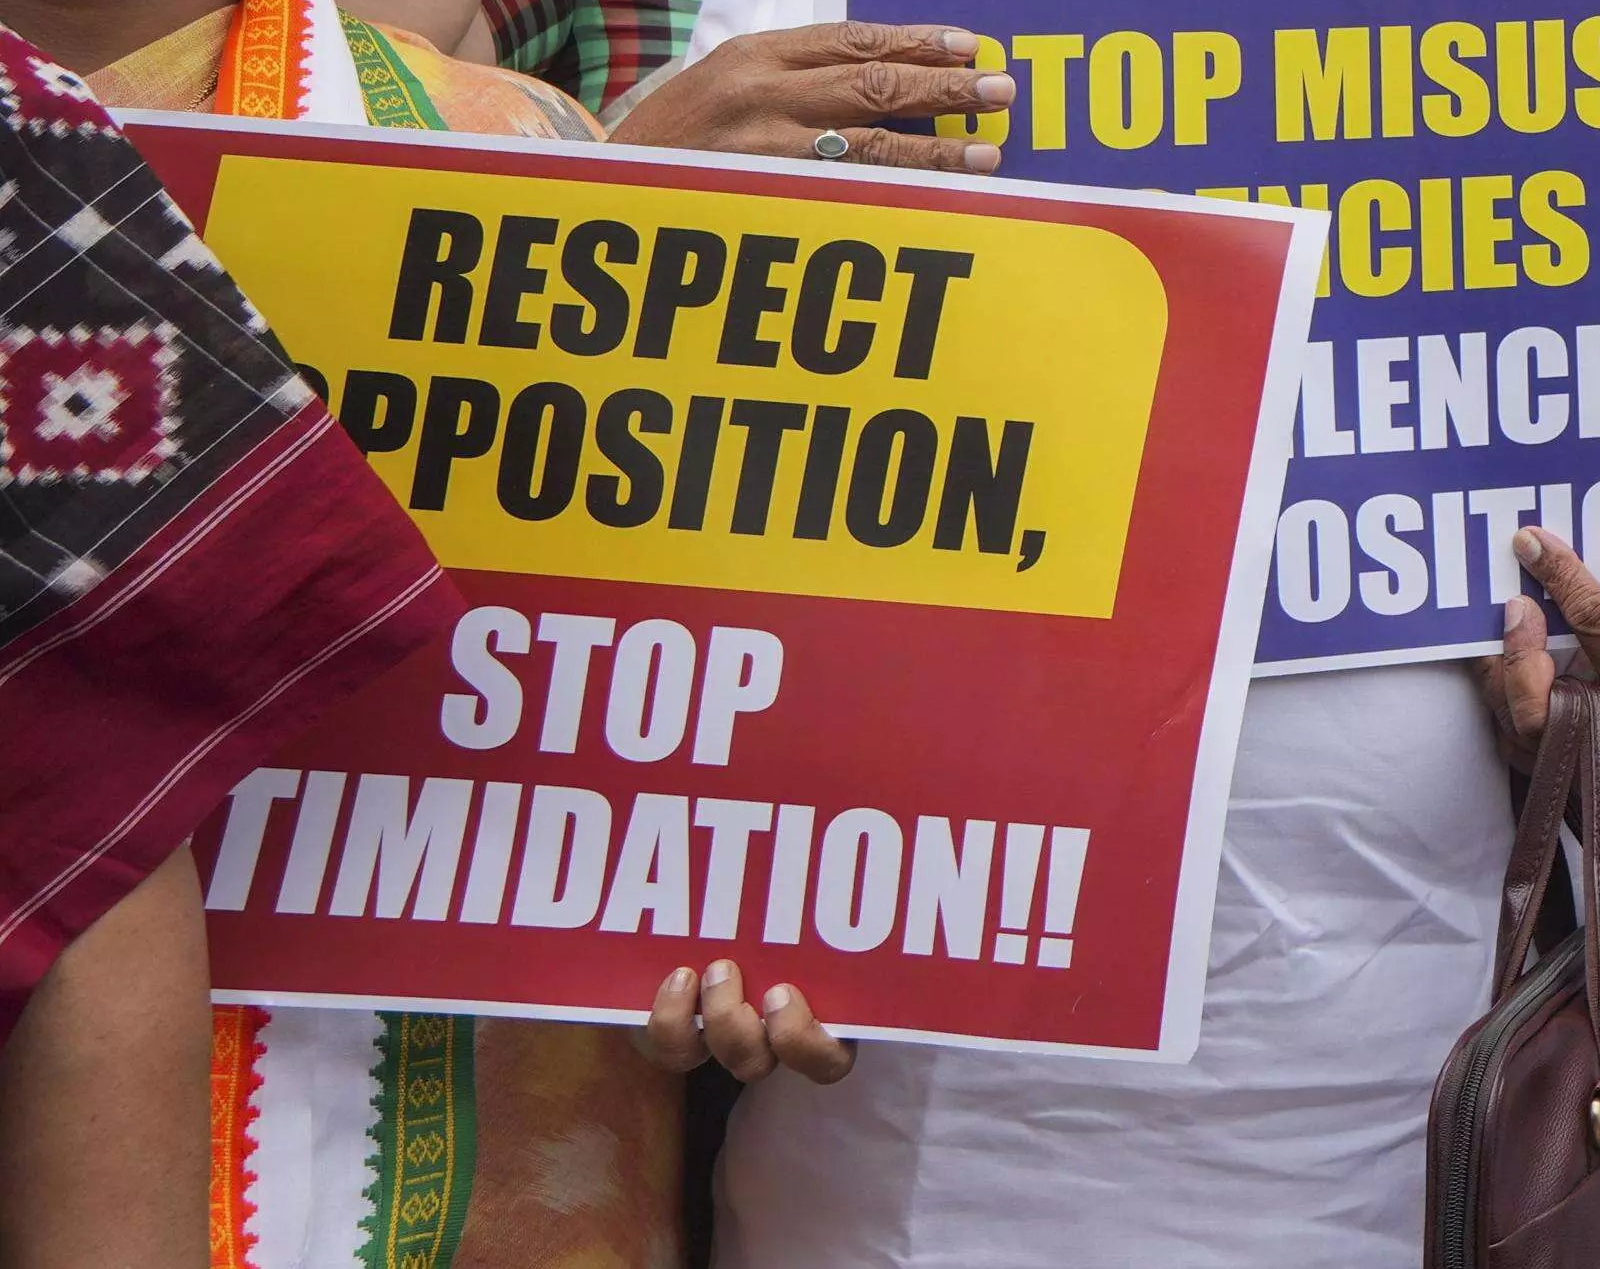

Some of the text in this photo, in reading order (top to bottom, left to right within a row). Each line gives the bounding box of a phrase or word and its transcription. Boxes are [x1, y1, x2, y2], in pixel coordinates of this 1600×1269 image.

[933, 29, 1243, 152] STOP
[388, 206, 974, 380] RESPECT
[1140, 170, 1590, 298] CIES
[439, 604, 785, 768] STOP
[202, 764, 1092, 970] TIMIDATION!!
